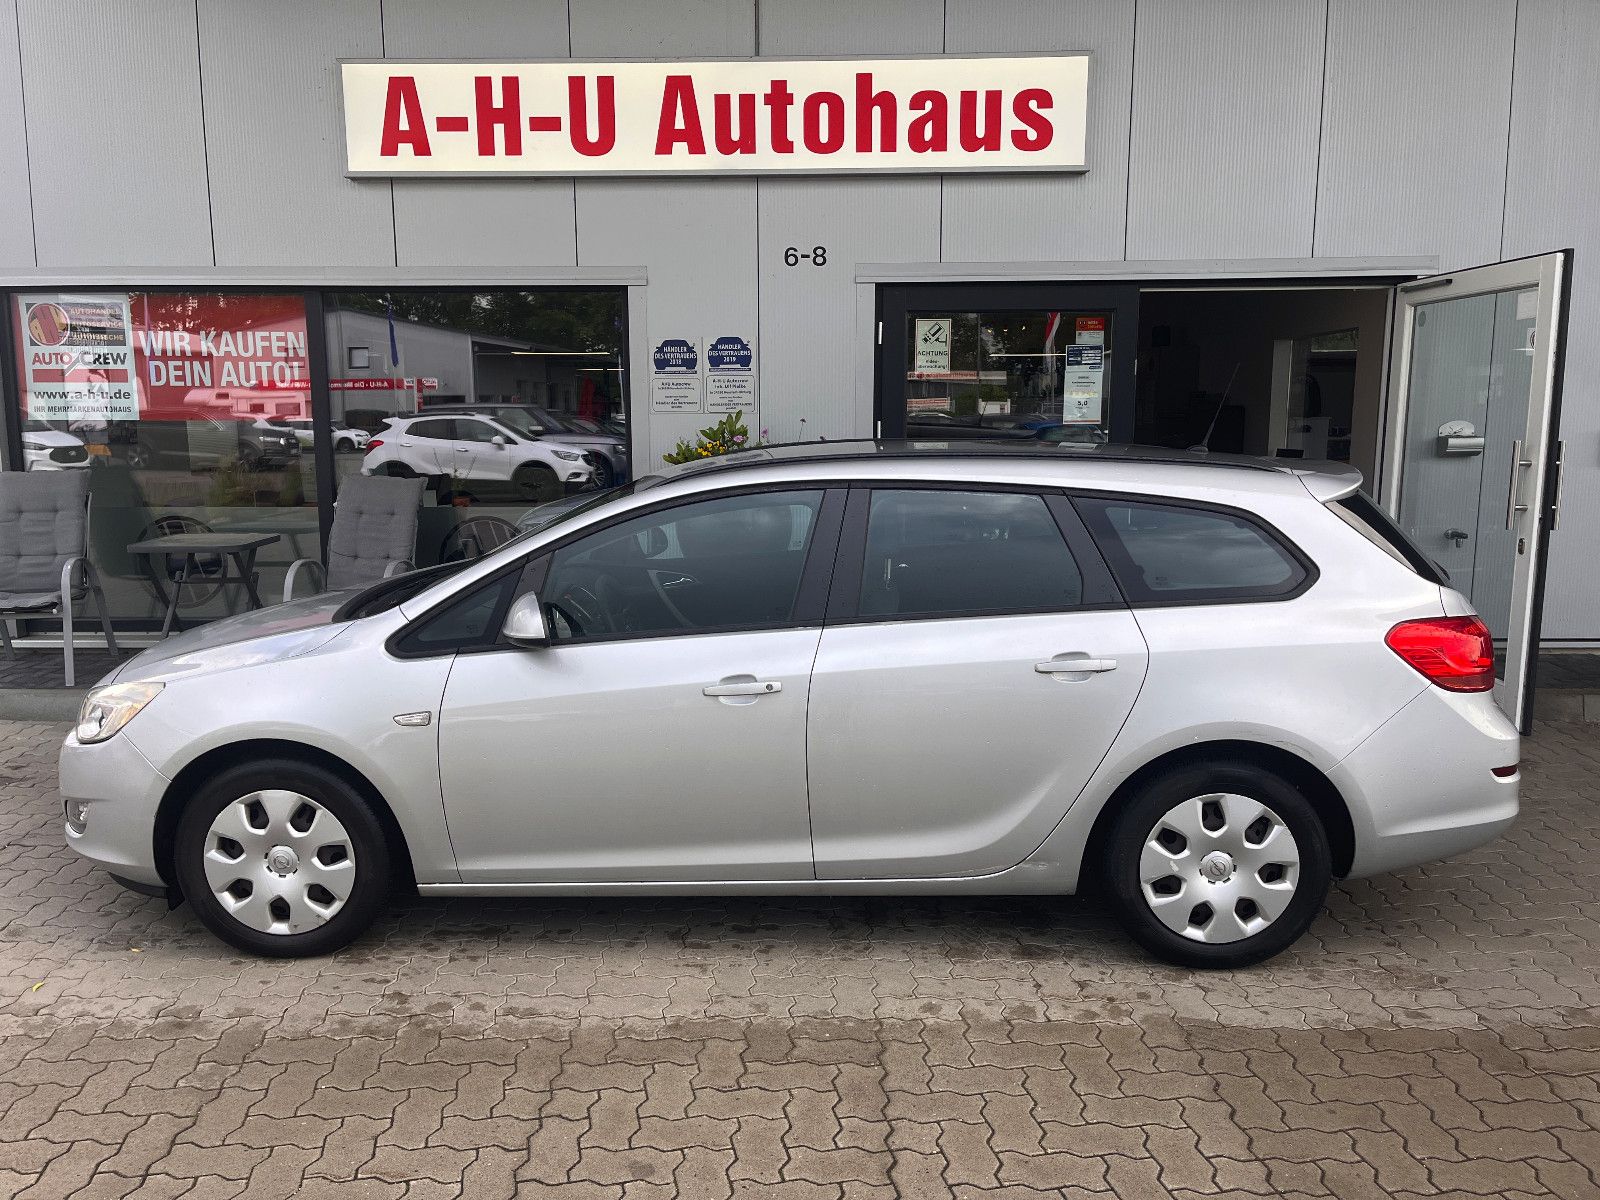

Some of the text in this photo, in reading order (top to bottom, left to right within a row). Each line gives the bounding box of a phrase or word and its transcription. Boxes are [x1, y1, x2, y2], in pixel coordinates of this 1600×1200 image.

[380, 72, 1054, 157] A-H-U Autohaus
[783, 246, 828, 267] 6-8
[138, 330, 306, 358] WIR KAUFEN
[31, 352, 128, 365] AUTO CREW
[149, 360, 301, 387] DEIN AUTO!
[33, 389, 131, 400] www.a-h-u.de
[33, 405, 132, 413] IHR MEHRMARKENAUTOHAUS
